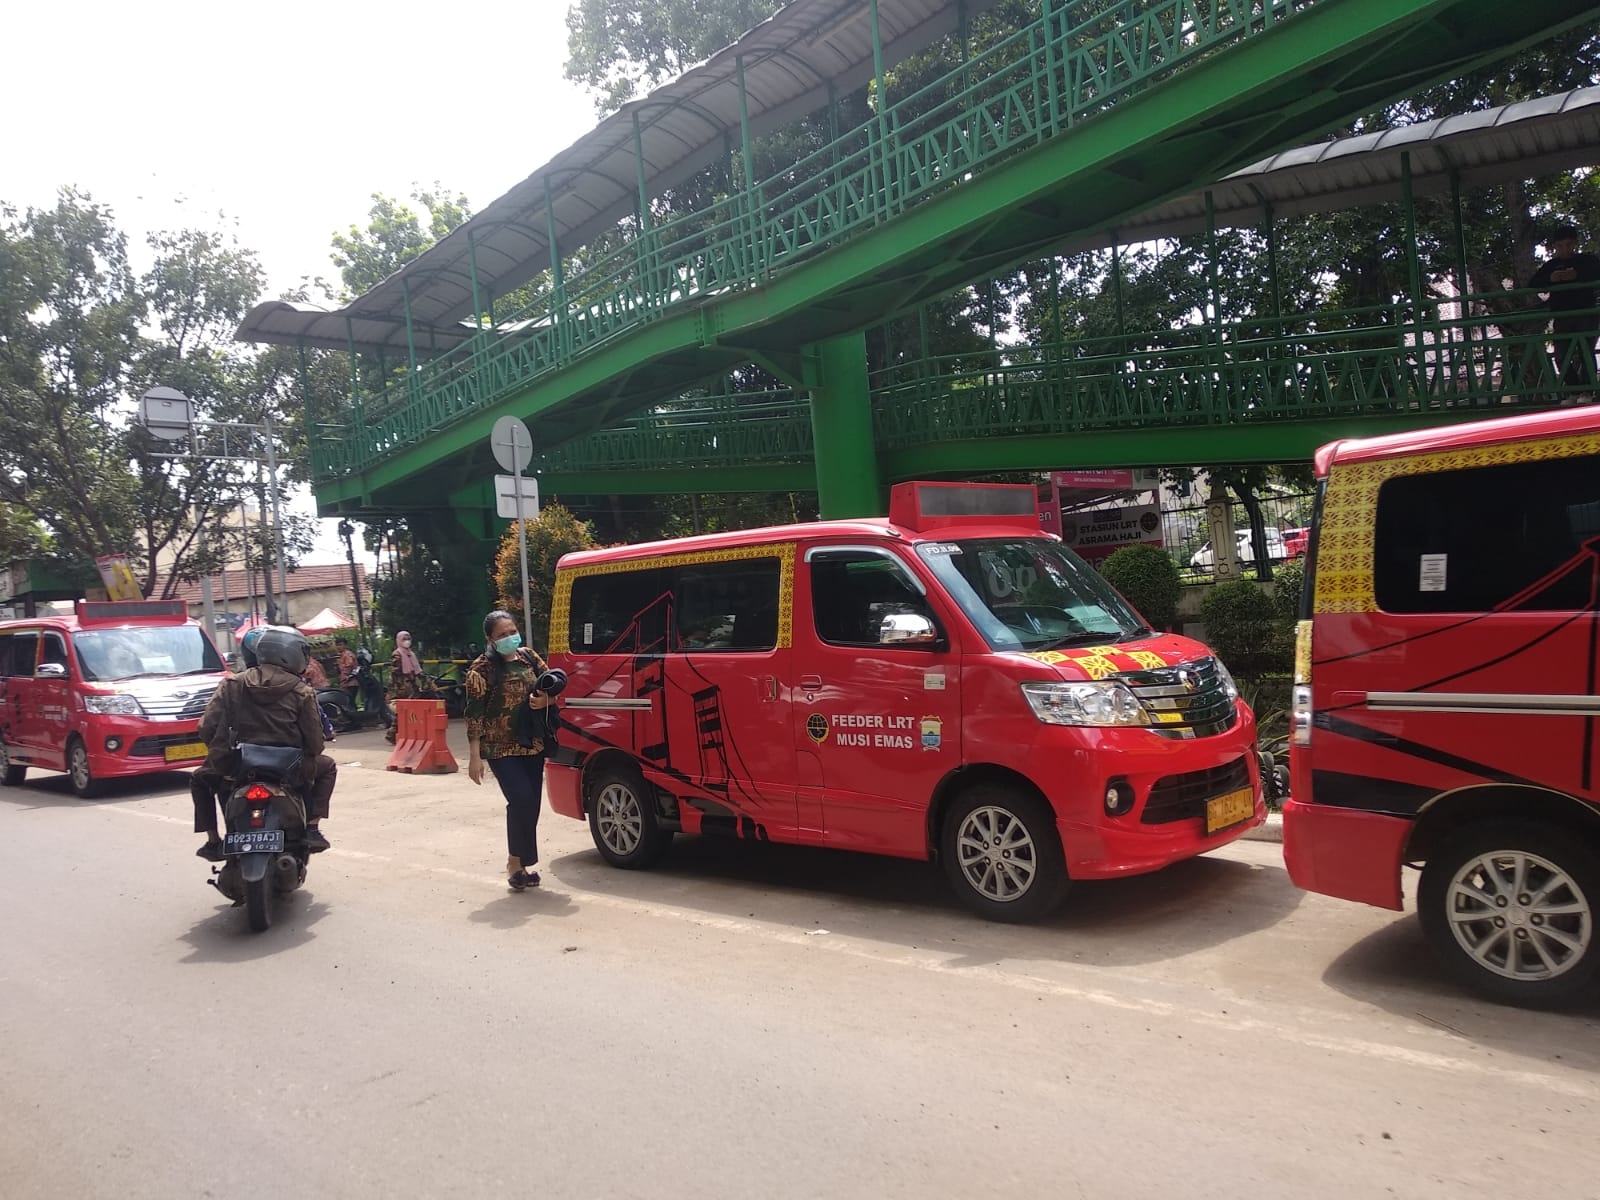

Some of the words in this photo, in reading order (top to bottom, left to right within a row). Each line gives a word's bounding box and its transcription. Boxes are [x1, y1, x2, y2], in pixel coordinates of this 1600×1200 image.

[1079, 522, 1119, 534] STASIUN
[1121, 520, 1138, 531] LRT
[1079, 534, 1118, 545] ASRAMA
[1119, 531, 1142, 541] HAJI
[831, 714, 884, 728] FEEDER
[887, 716, 915, 729] LRT
[836, 733, 870, 747] MUSI
[874, 734, 913, 749] EMAS
